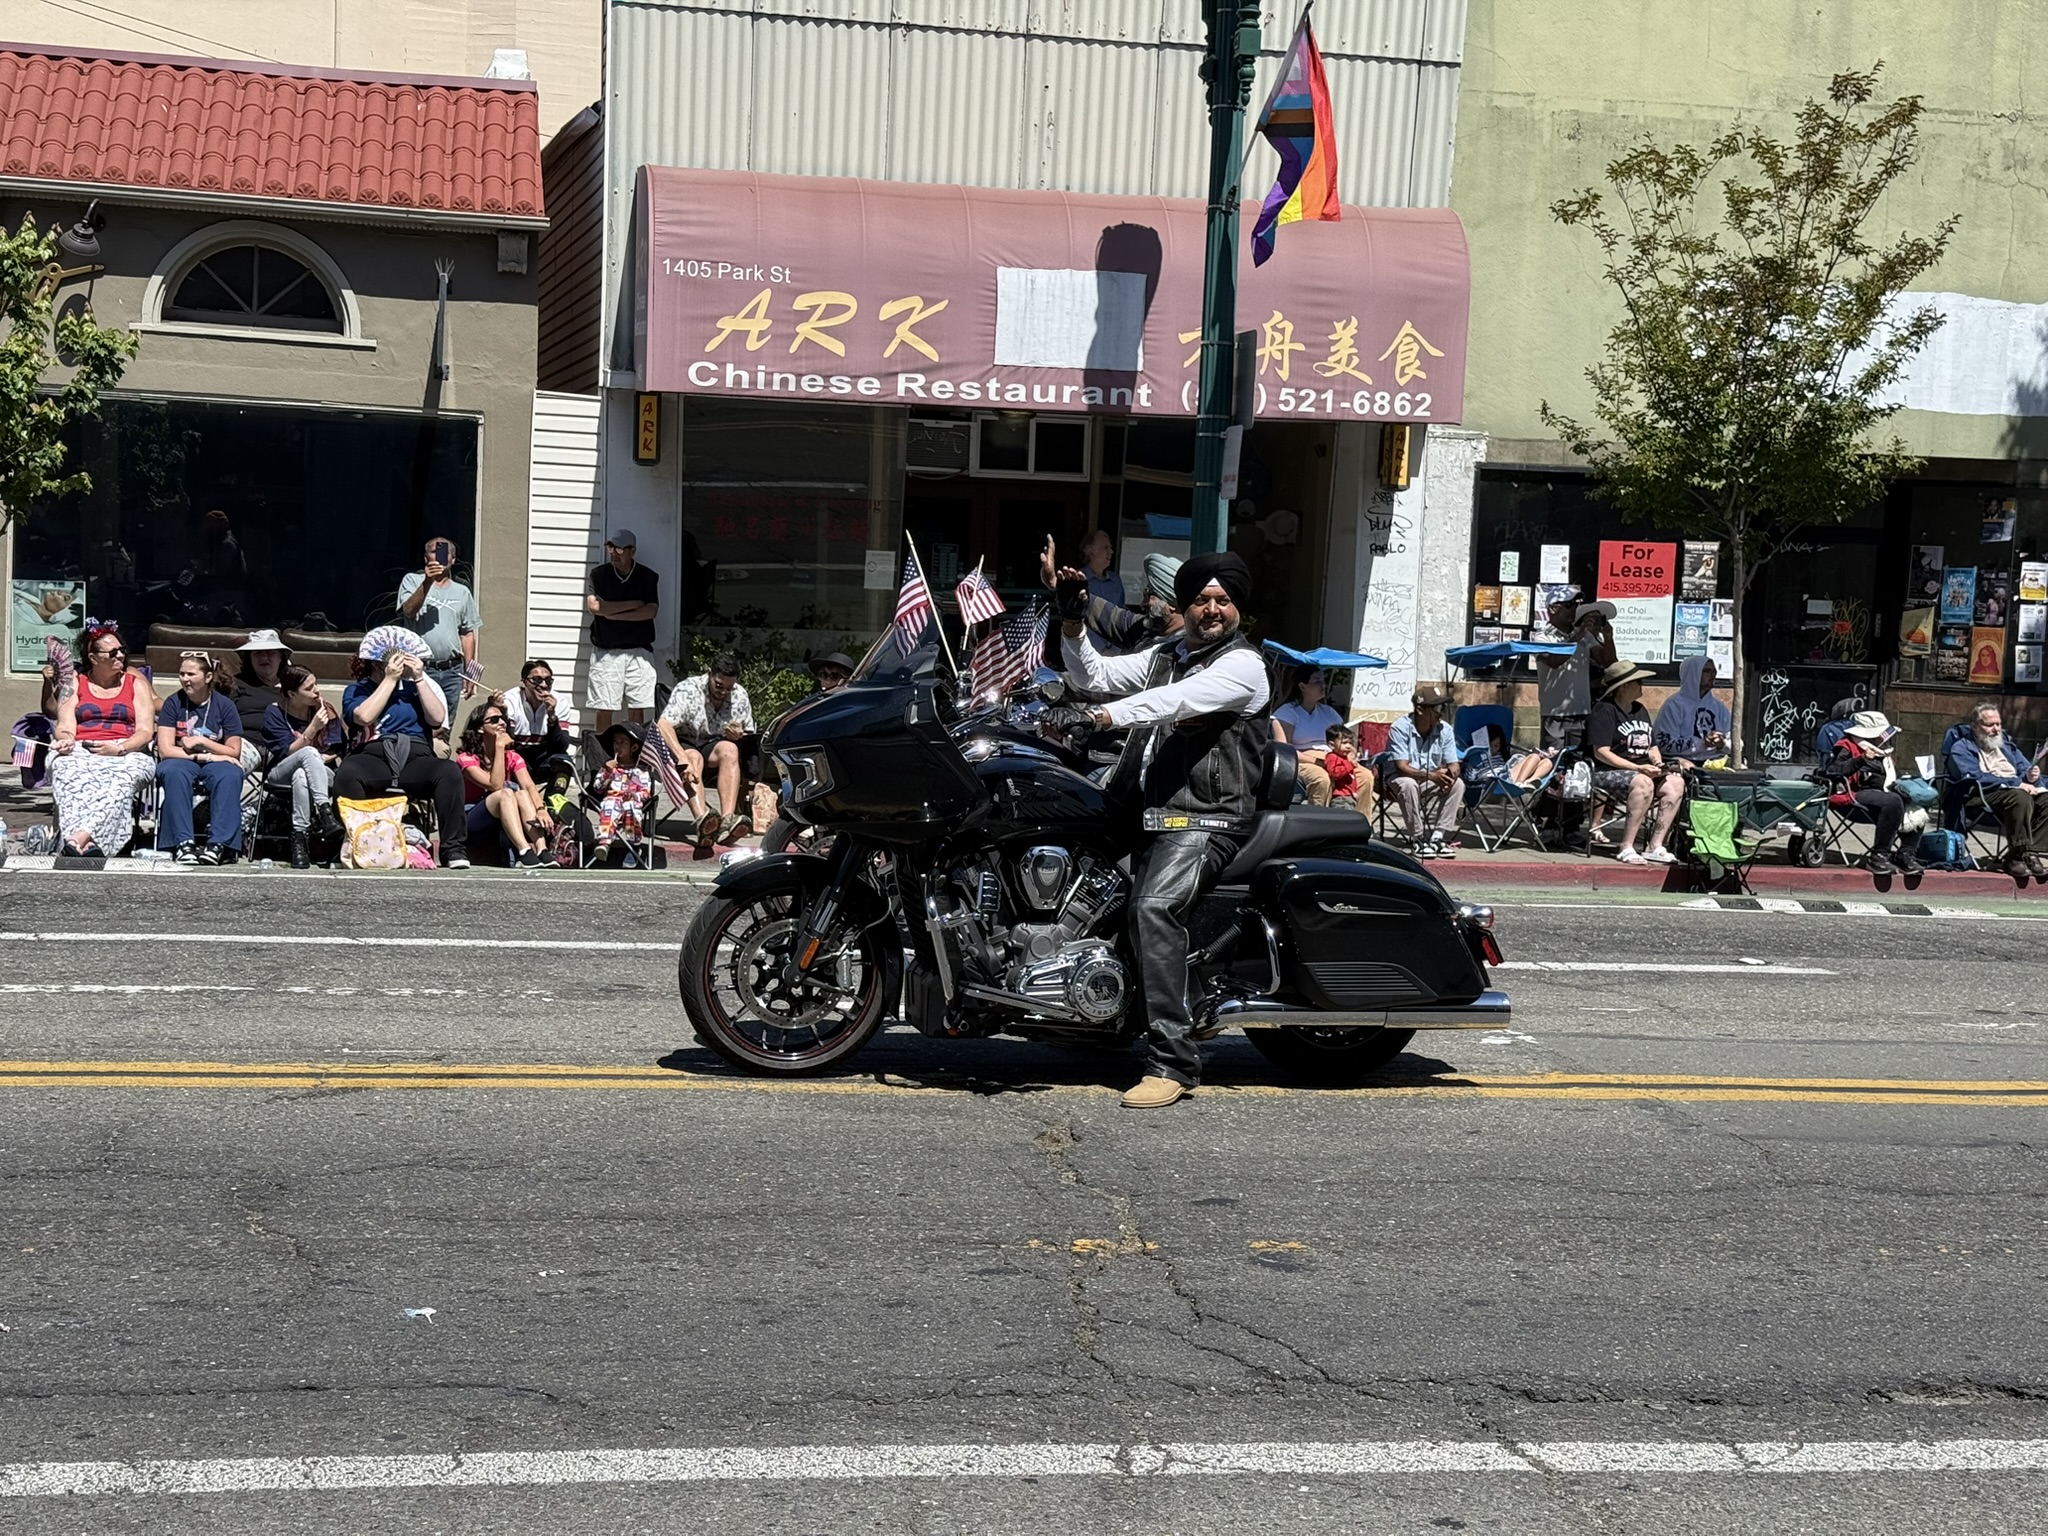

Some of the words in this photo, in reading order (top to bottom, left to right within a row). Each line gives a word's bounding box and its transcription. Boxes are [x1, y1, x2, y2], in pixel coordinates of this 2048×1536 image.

[662, 258, 712, 278] 1405
[718, 263, 764, 282] Park
[769, 266, 792, 284] St
[704, 288, 949, 362] ARK
[687, 361, 881, 396] Chinese
[897, 373, 1152, 408] Restaurant
[1278, 387, 1432, 417] 521-6862
[642, 401, 655, 452] ARK
[1622, 544, 1655, 561] For
[1609, 562, 1665, 579] Lease
[1602, 582, 1670, 595] 415.395.7262
[1627, 606, 1647, 614] Choi
